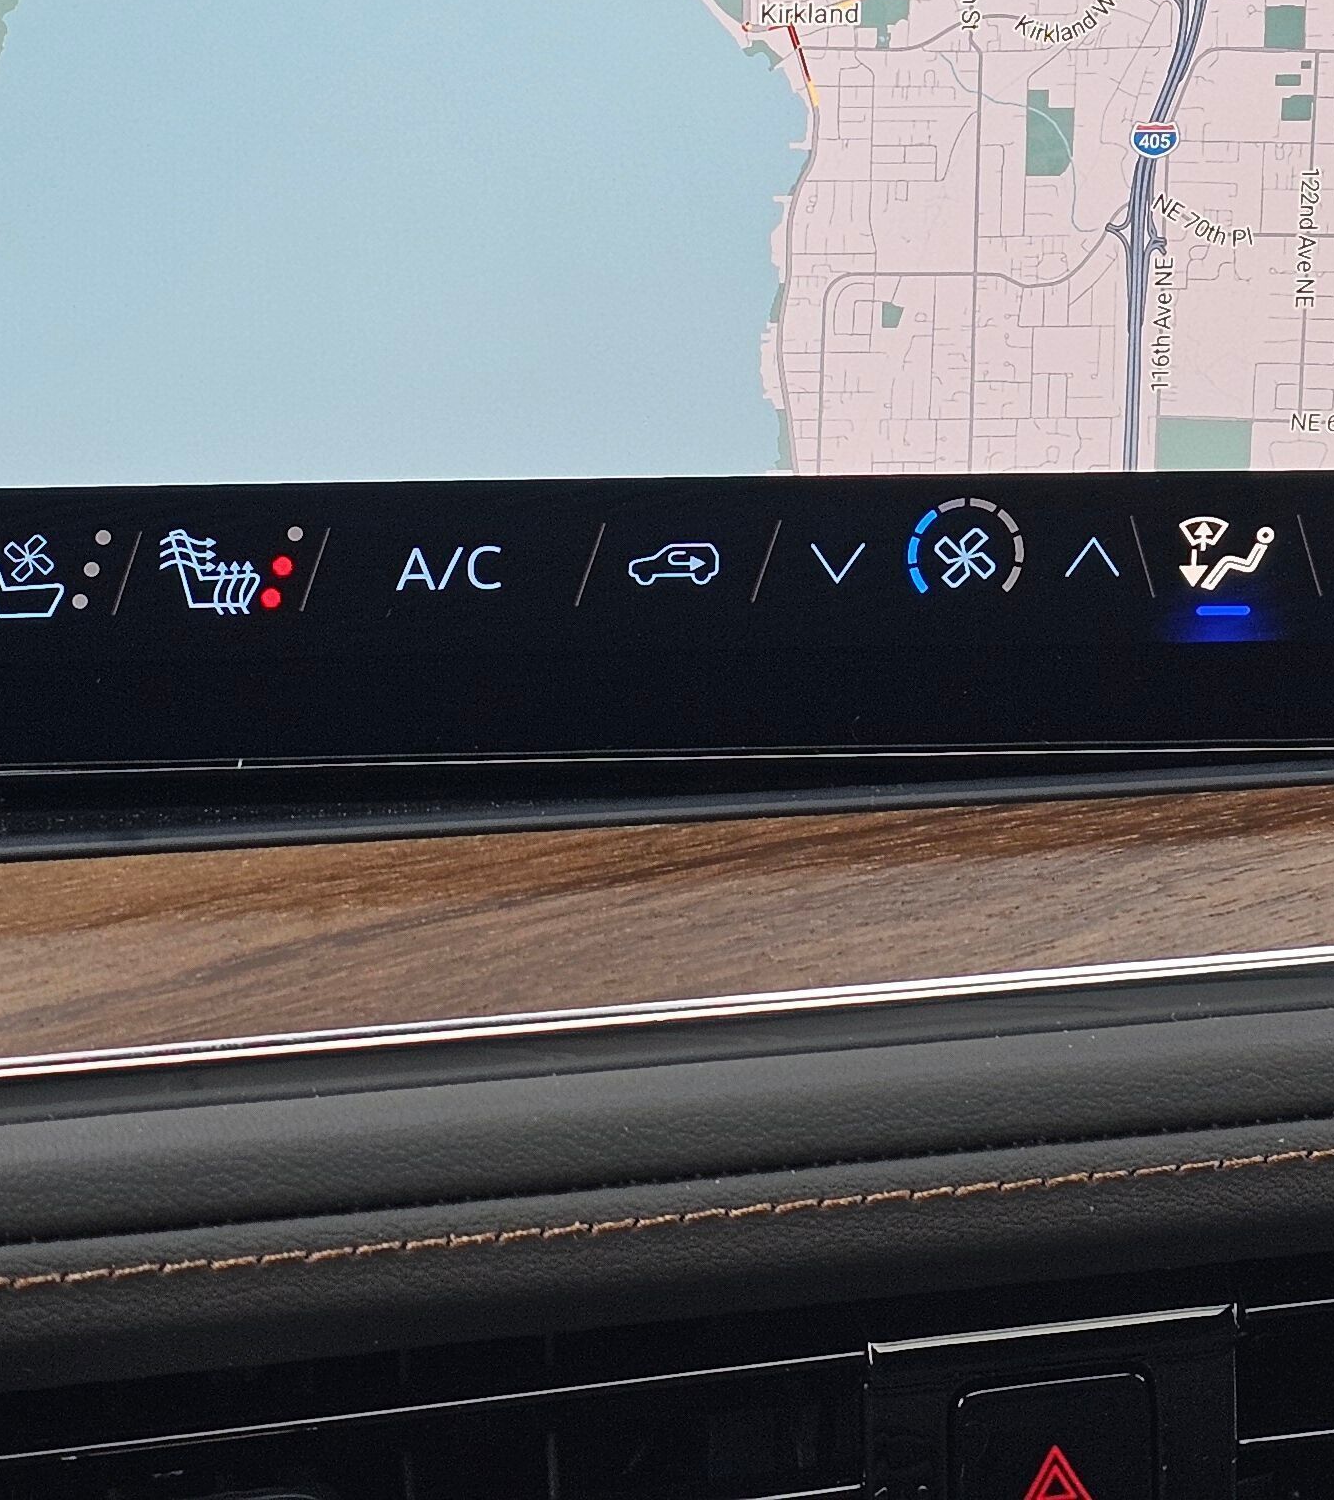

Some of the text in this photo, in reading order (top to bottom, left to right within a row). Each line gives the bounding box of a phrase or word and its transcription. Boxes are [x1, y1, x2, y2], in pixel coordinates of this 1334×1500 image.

[761, 4, 860, 24] Kirkland
[962, 9, 980, 30] St
[1014, 4, 1098, 43] Kirkland
[1138, 133, 1171, 150] 405
[1152, 195, 1254, 246] NE 70th Pl
[1294, 168, 1321, 308] 122nd Ave NE
[1150, 258, 1175, 390] 116th Ave NE
[1291, 414, 1322, 431] NE
[397, 547, 501, 592] A/C
